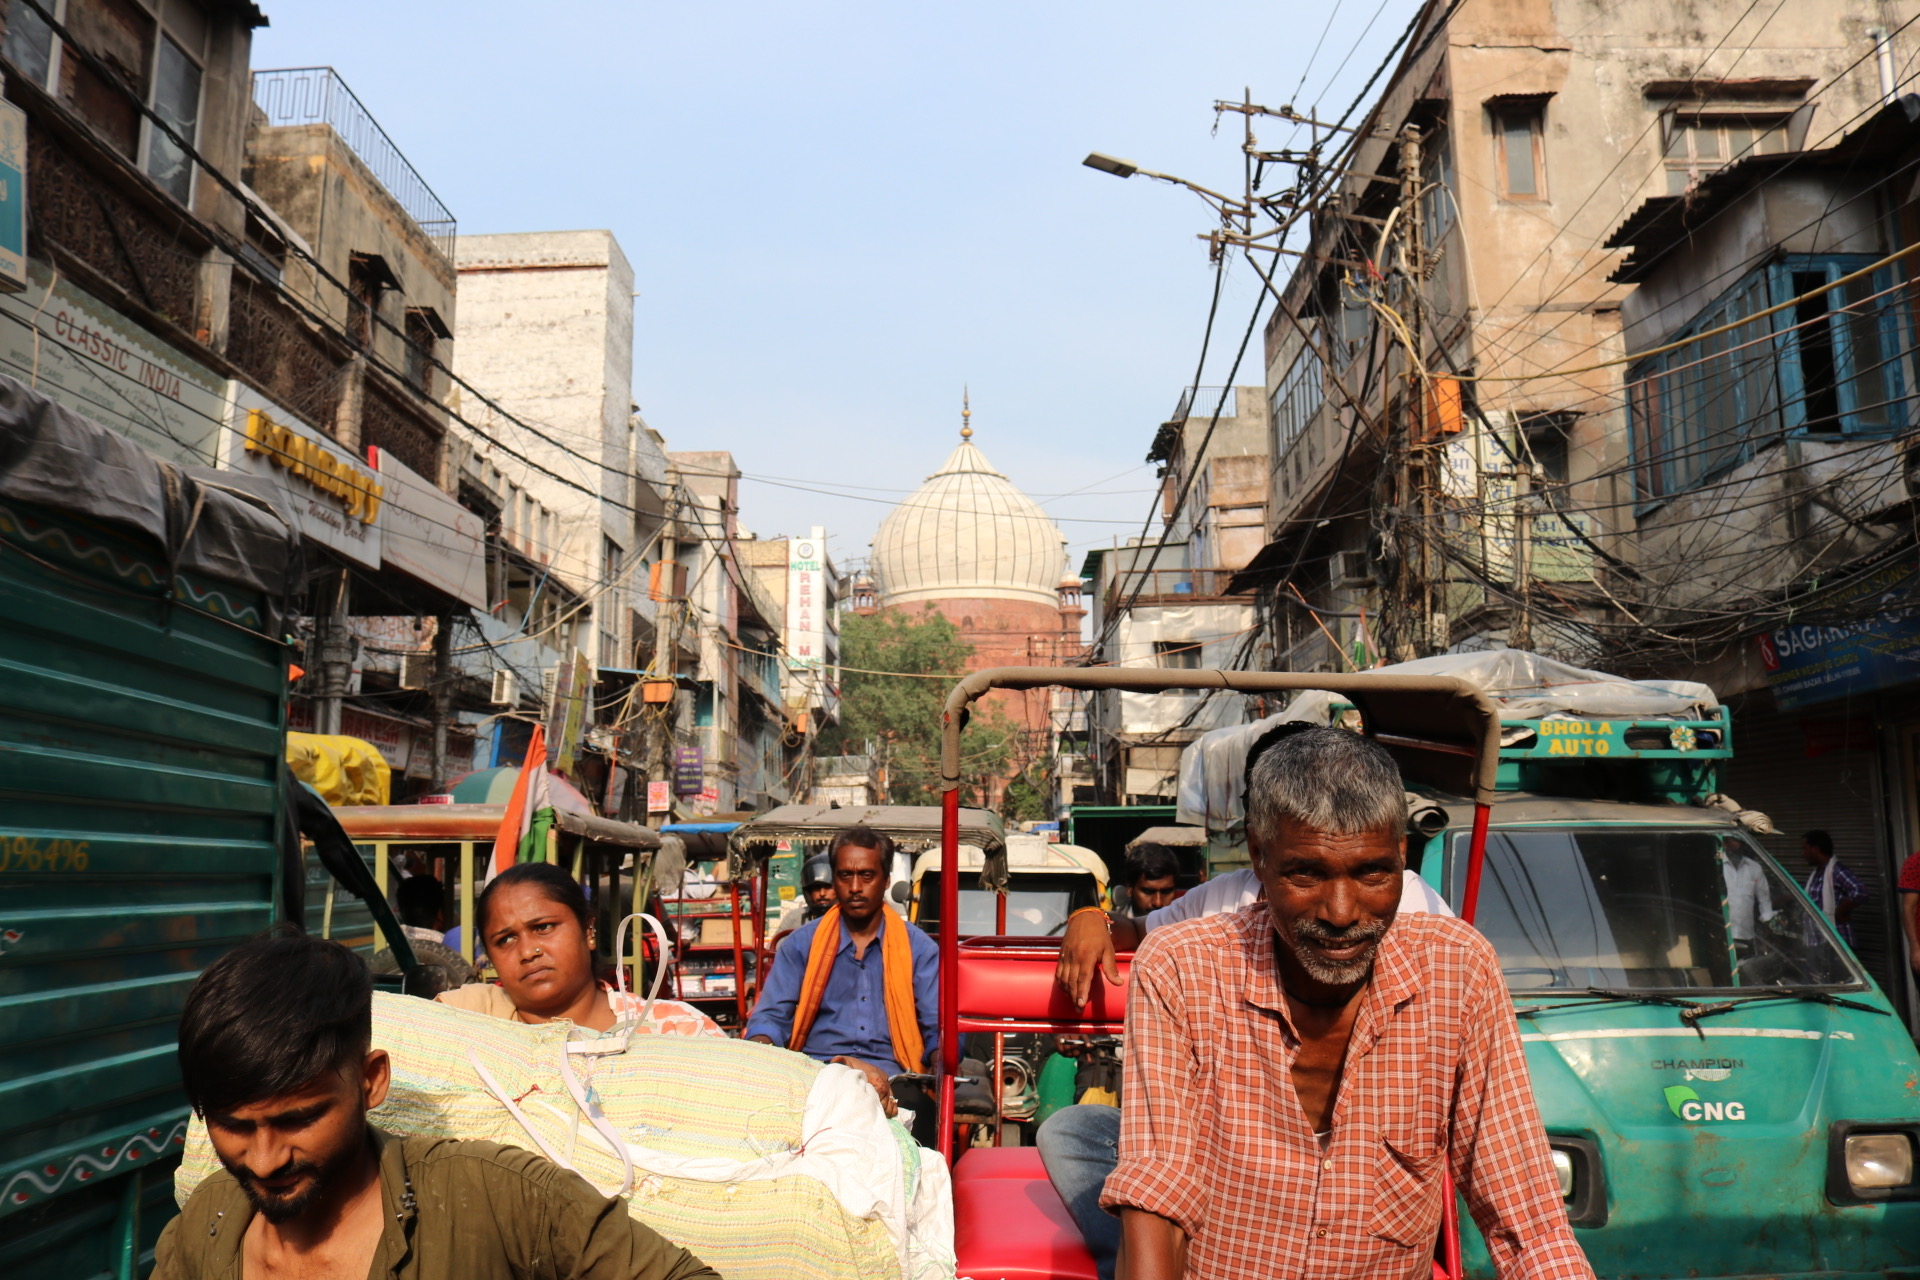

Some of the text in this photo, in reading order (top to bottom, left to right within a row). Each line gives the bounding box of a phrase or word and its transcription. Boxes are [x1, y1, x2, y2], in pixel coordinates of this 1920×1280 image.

[55, 311, 181, 401] CLASSIC INDIA
[790, 562, 820, 571] HOTEL
[1538, 722, 1614, 736] BHOLA
[1549, 739, 1610, 756] AUTO
[1651, 1059, 1744, 1070] CHAMPION
[1682, 1102, 1745, 1121] CNG
